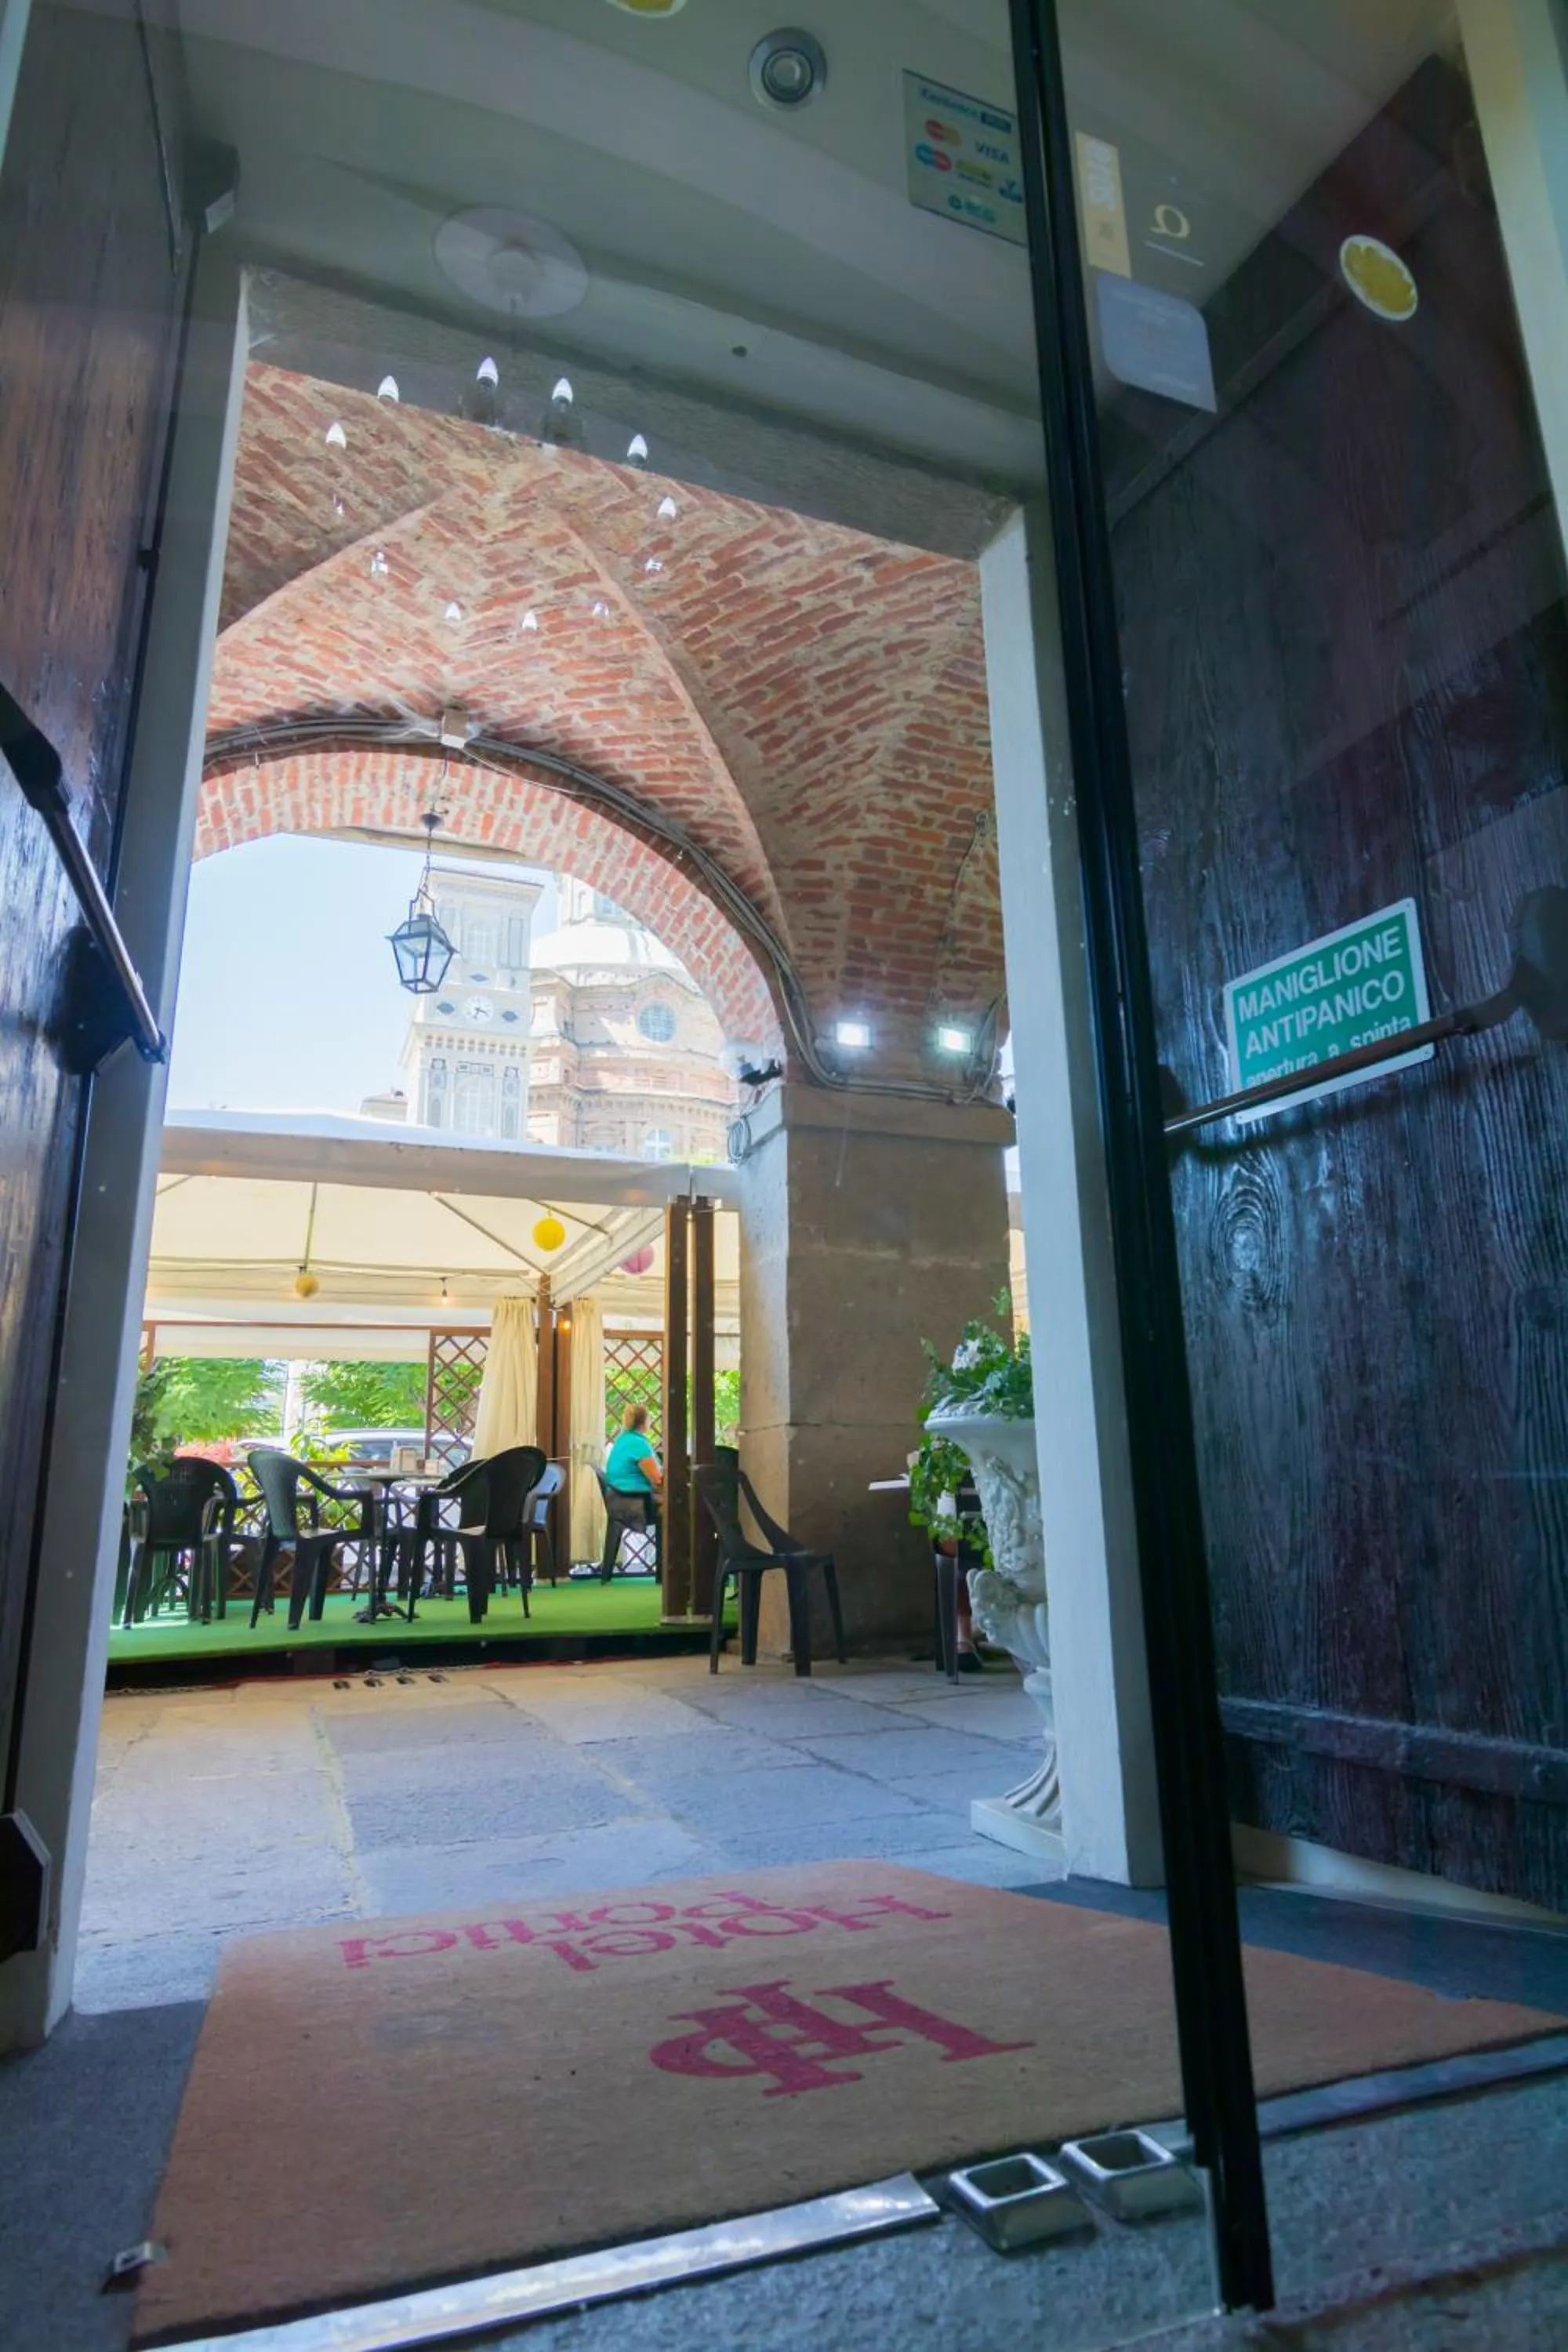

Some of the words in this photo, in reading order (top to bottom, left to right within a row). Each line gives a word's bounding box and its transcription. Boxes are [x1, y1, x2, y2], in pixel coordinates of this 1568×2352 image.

[975, 140, 1009, 165] VISA
[1238, 926, 1403, 1024] MANIGLIONE
[1245, 970, 1405, 1059] ANTIPANICO
[1327, 1042, 1341, 1058] a
[531, 1894, 953, 1972] Hotel
